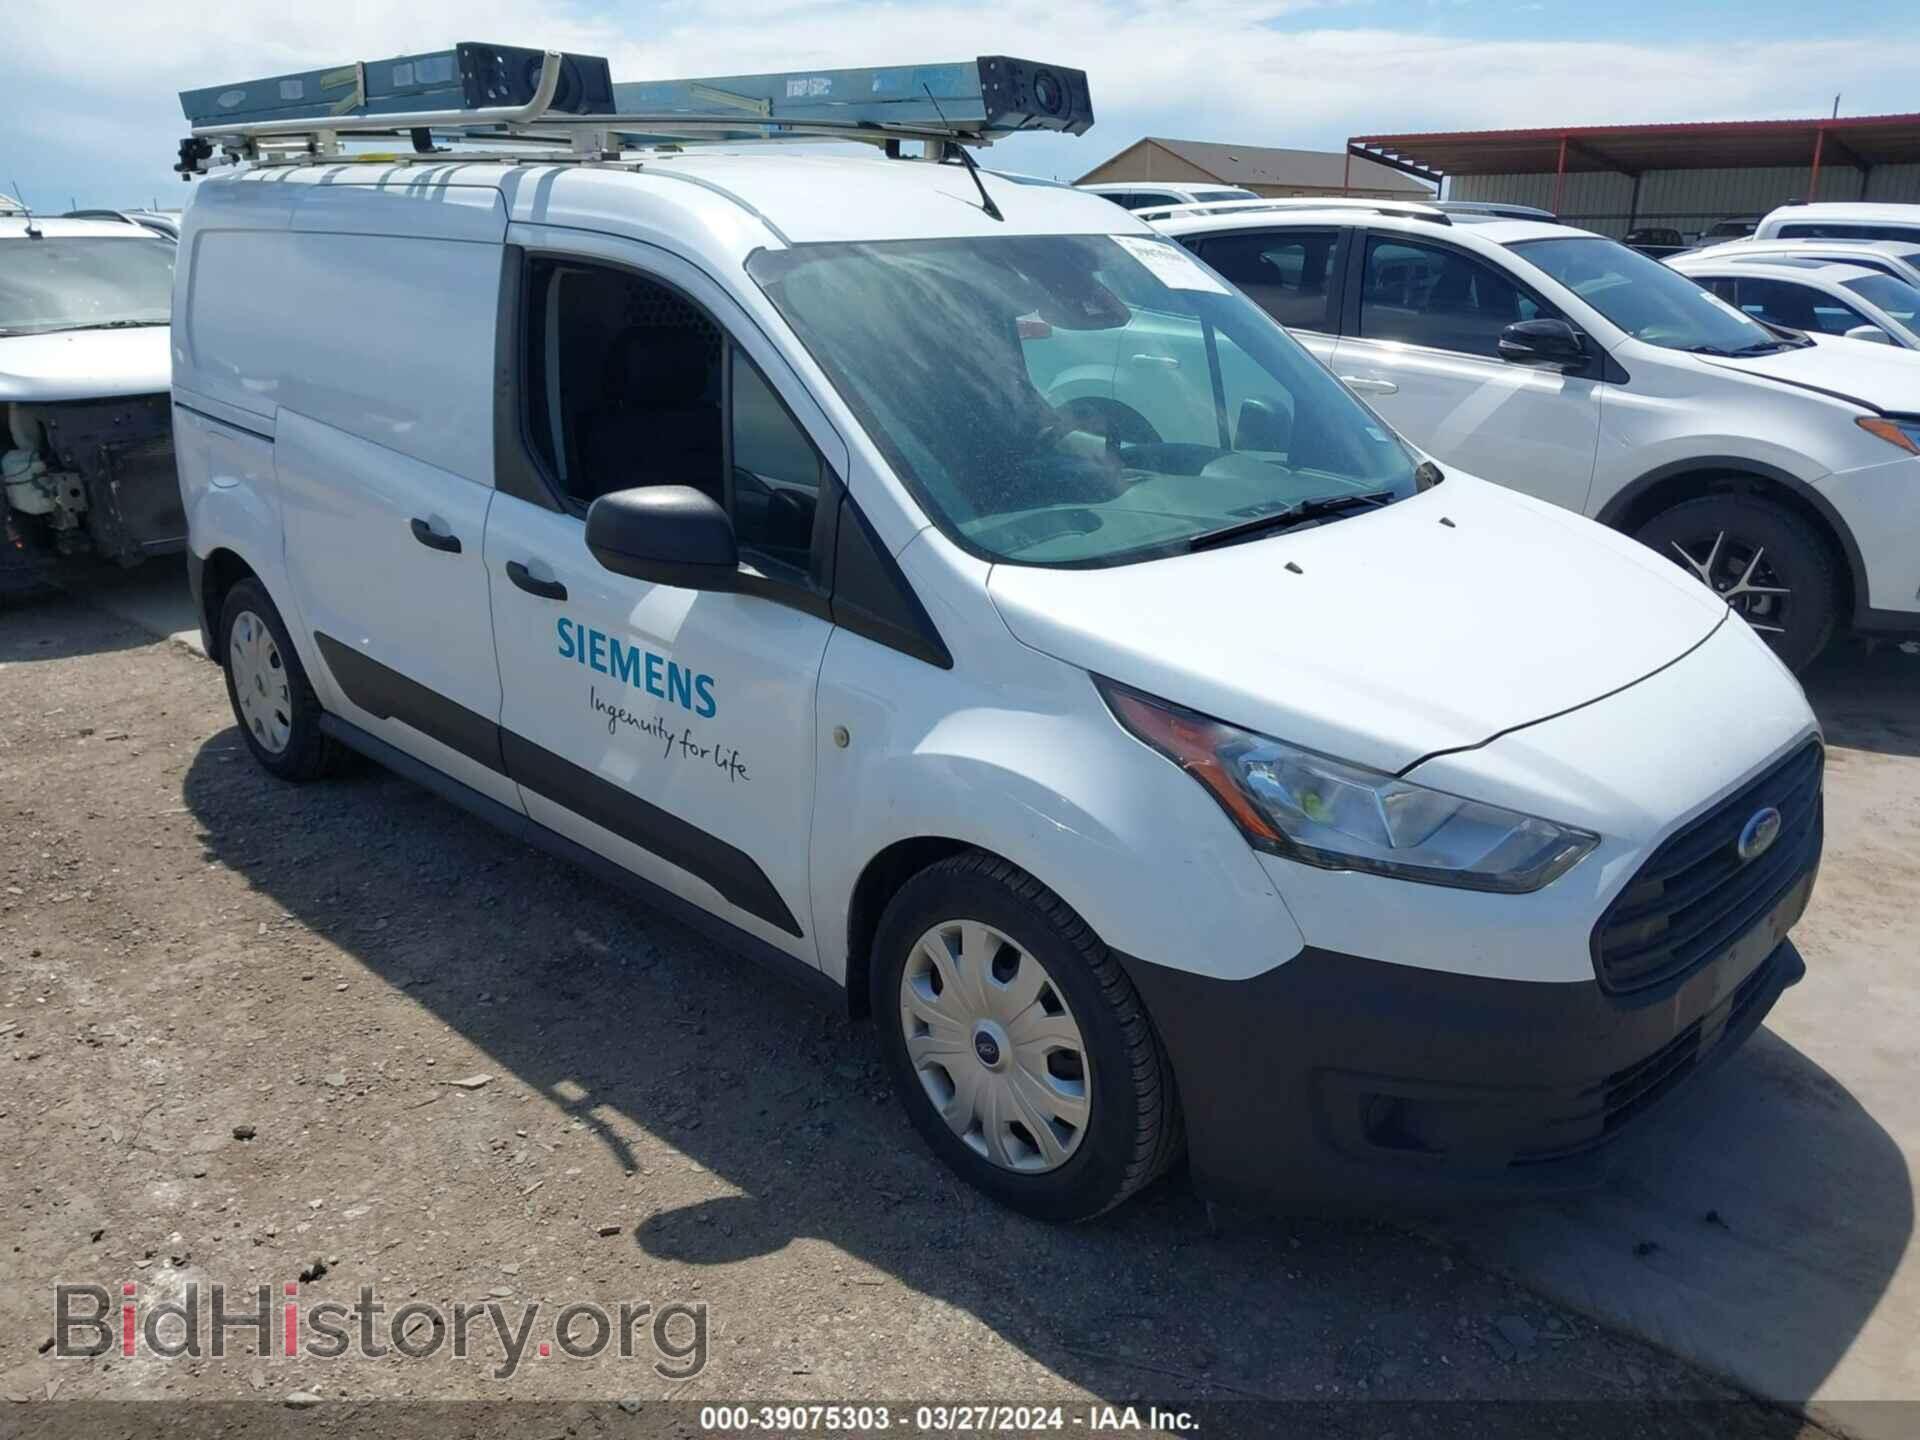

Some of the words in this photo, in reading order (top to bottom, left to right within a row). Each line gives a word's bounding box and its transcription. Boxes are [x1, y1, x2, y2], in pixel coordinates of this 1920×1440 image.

[557, 617, 717, 719] SIEMENS
[589, 685, 675, 759] Ingenuity
[679, 728, 712, 759] for
[713, 743, 751, 783] life
